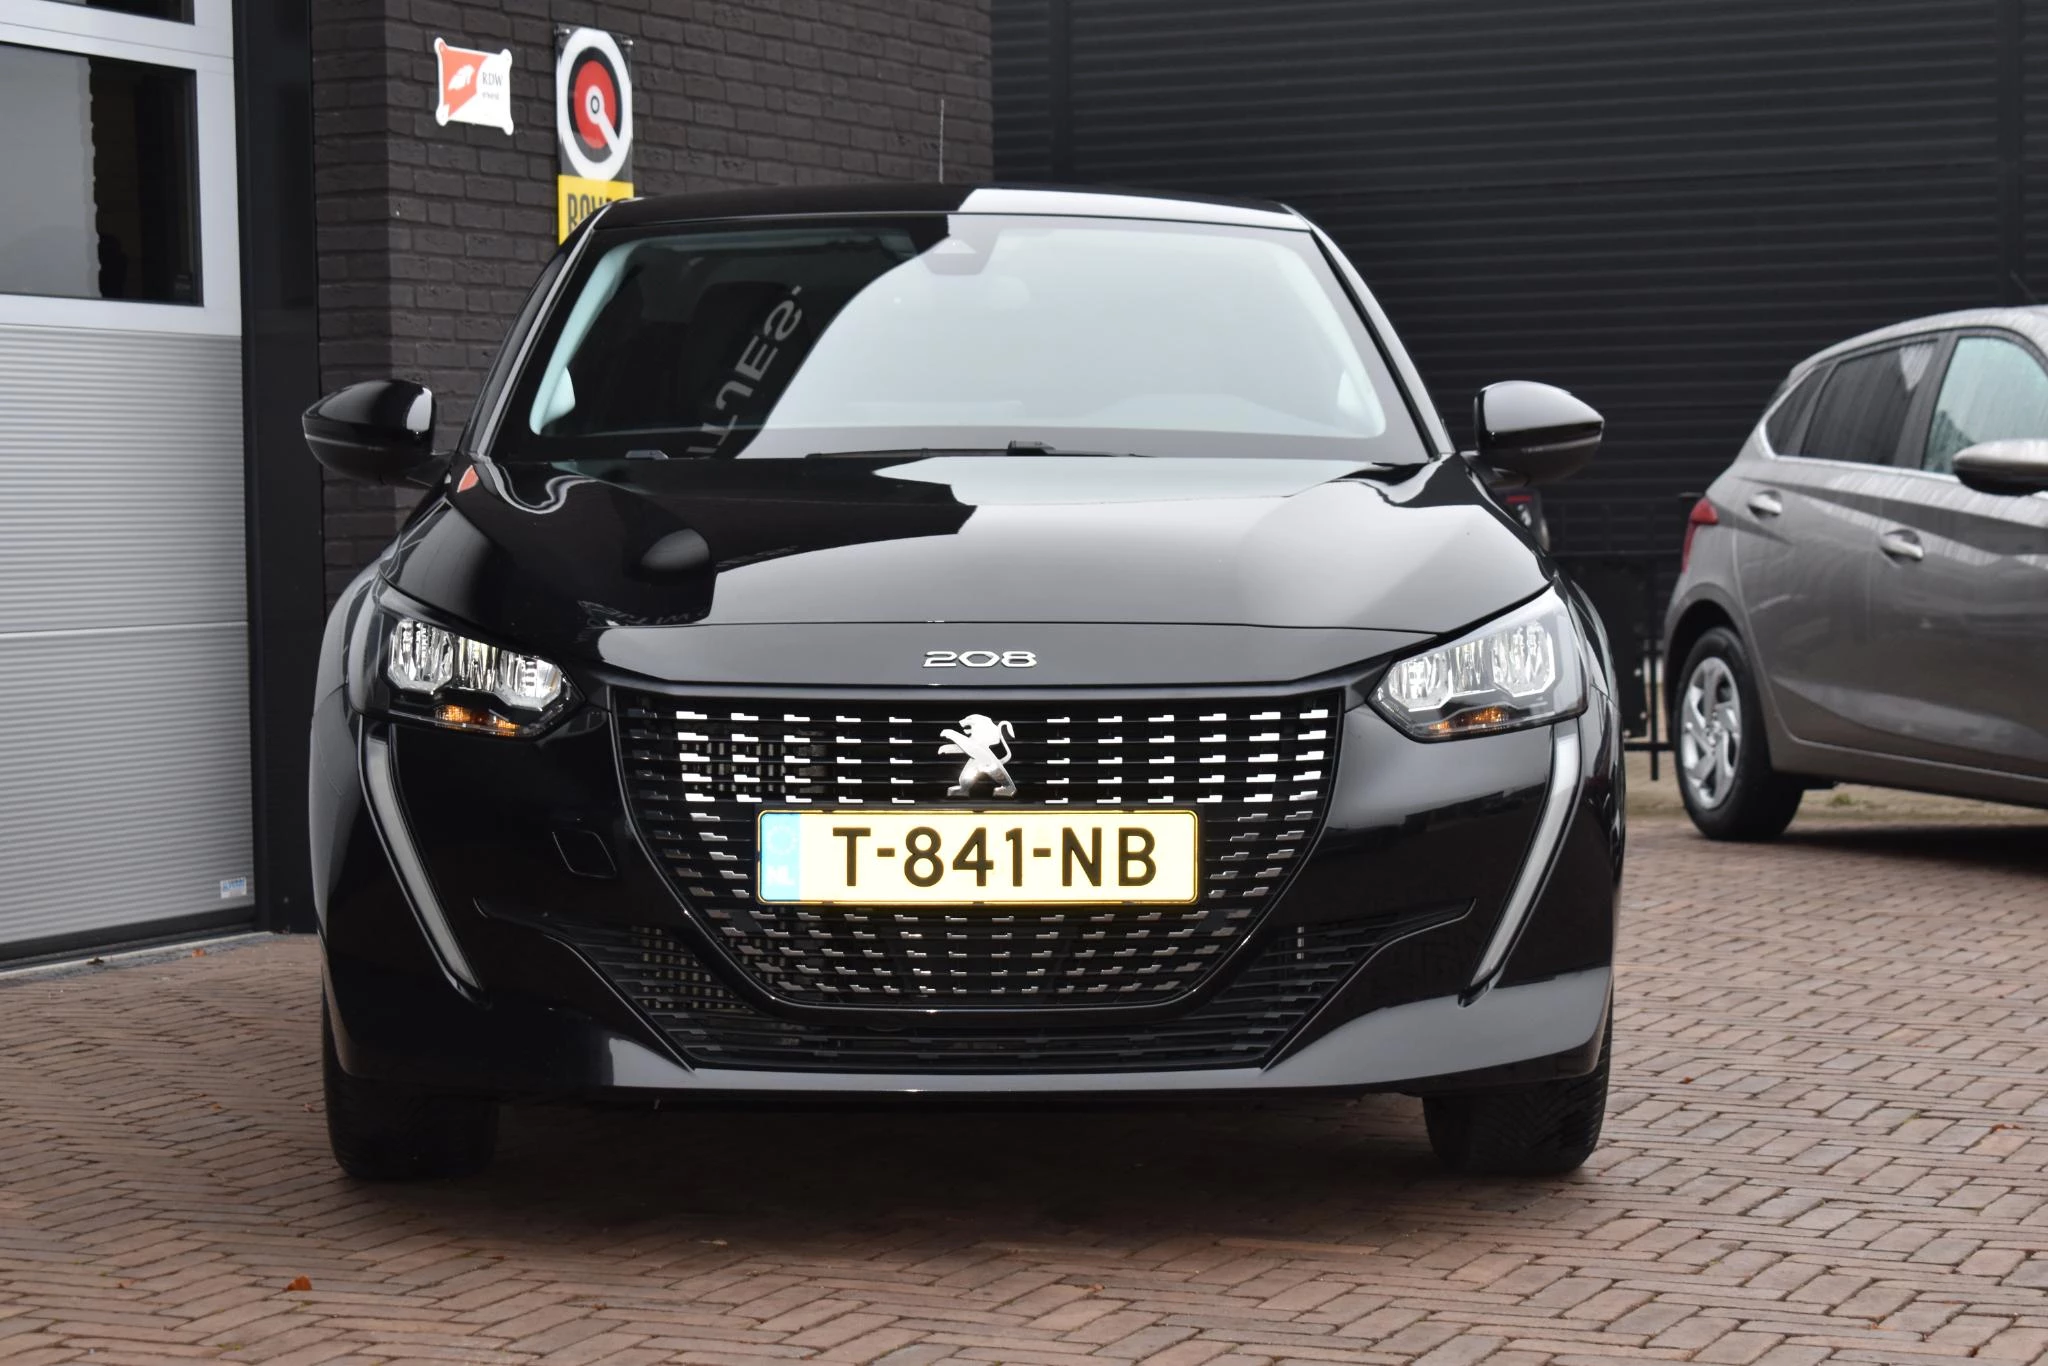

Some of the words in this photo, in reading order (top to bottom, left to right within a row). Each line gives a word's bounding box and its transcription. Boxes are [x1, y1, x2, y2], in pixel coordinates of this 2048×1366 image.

[482, 71, 503, 87] RDW
[922, 650, 1038, 668] 208
[832, 826, 1157, 888] T-841-NB
[767, 864, 796, 886] NL
